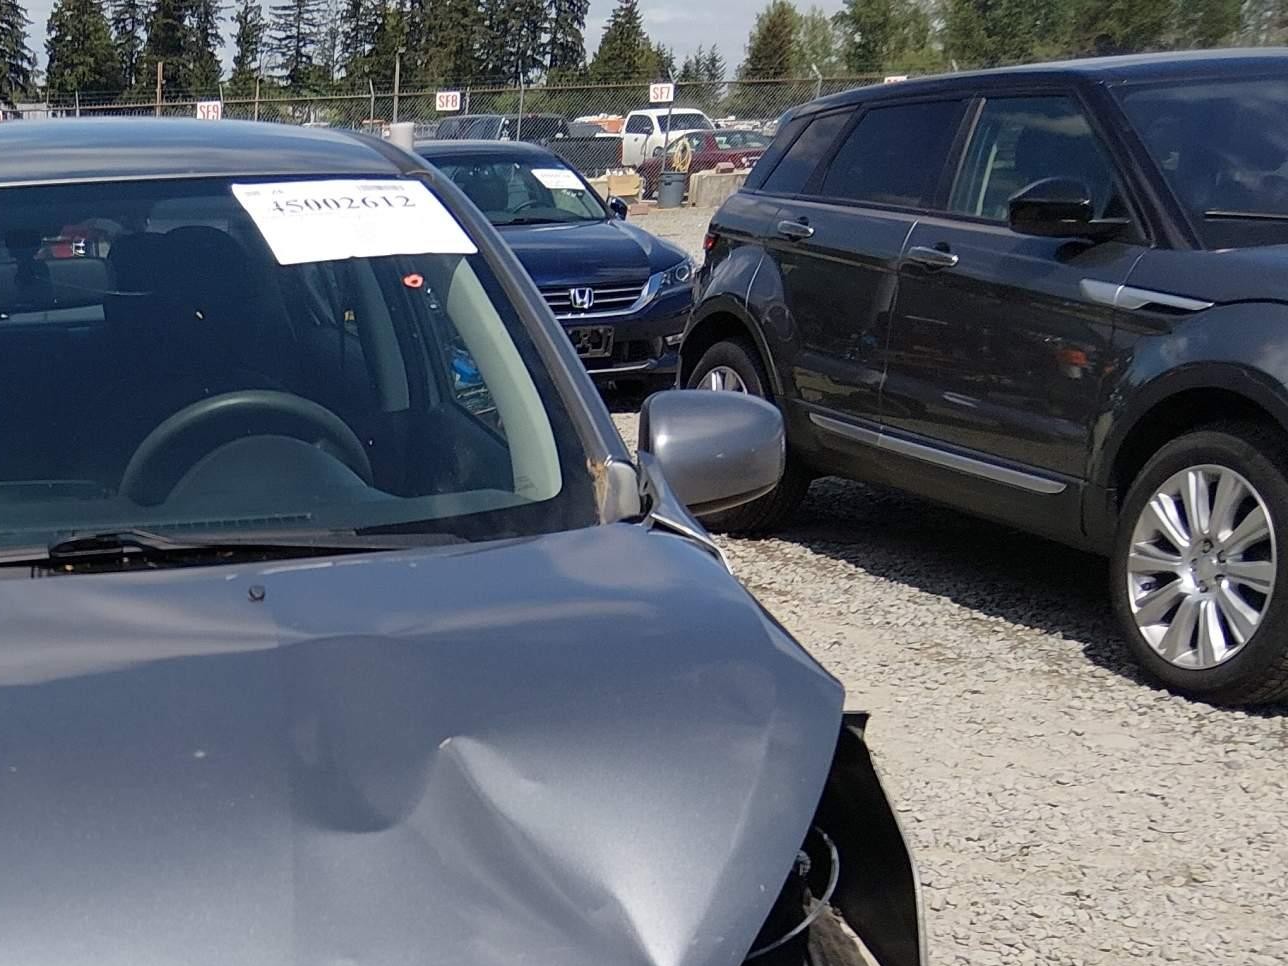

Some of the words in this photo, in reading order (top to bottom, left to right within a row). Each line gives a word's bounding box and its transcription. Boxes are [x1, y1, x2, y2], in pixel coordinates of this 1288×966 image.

[652, 86, 671, 100] SF7
[438, 94, 458, 108] SF8
[199, 104, 219, 120] SF9
